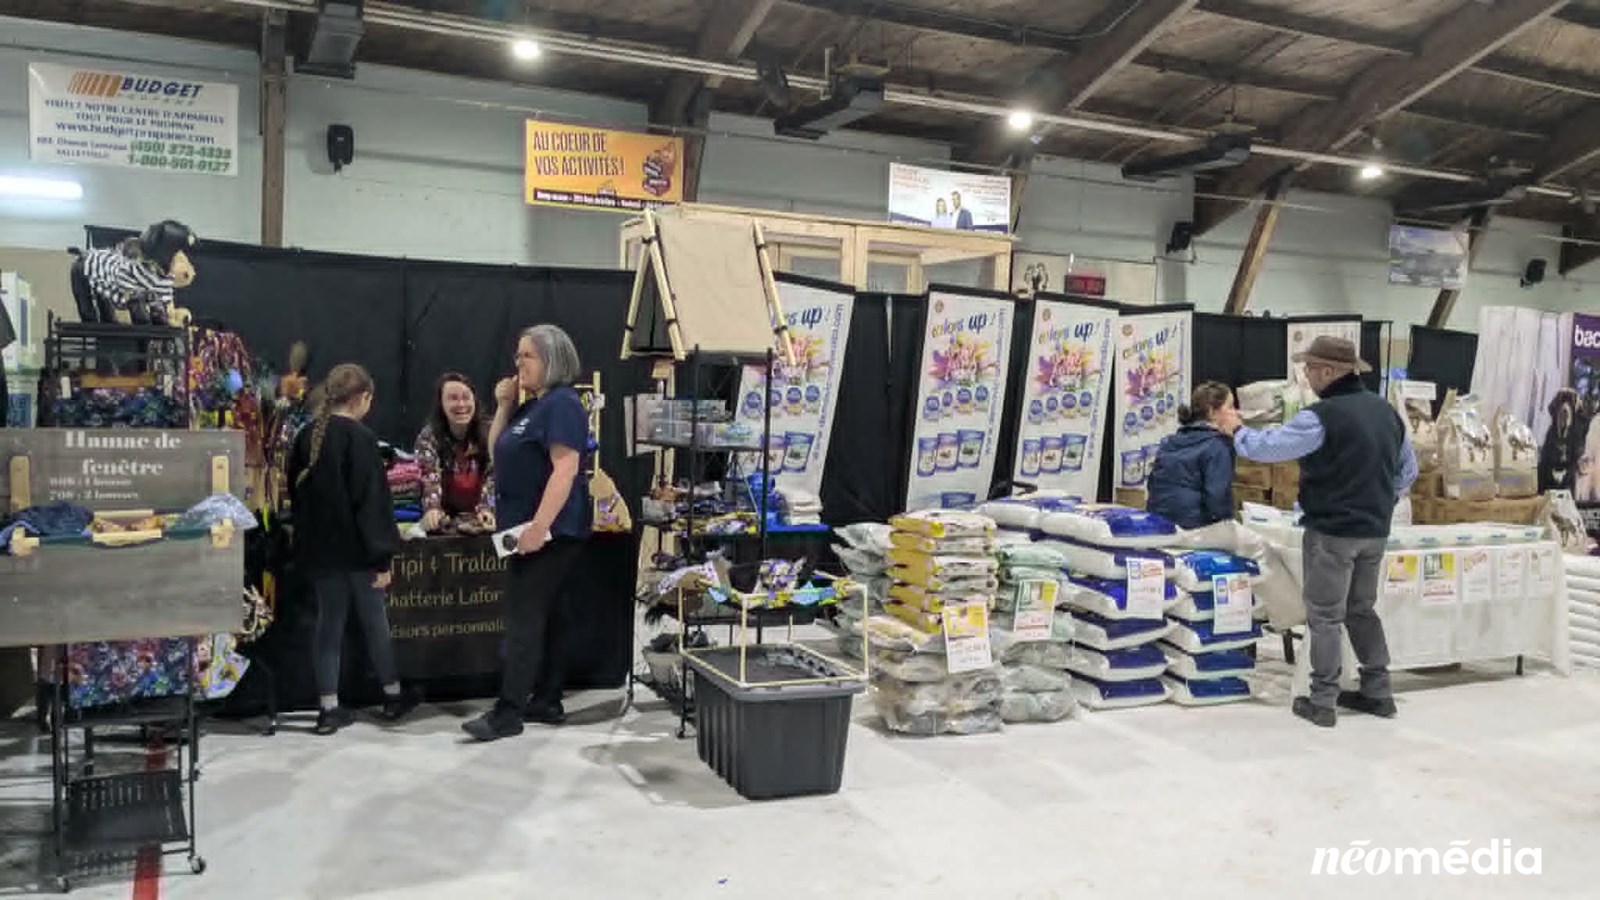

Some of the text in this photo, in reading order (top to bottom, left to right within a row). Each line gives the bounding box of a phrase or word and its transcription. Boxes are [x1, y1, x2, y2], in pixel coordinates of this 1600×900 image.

[121, 77, 203, 98] BUDGET
[533, 130, 607, 153] AU COEUR DE
[535, 156, 559, 176] VOS
[801, 308, 823, 330] up
[968, 313, 988, 335] up
[1074, 322, 1094, 342] up
[64, 431, 182, 449] Hamac de
[81, 457, 164, 476] fenêtre
